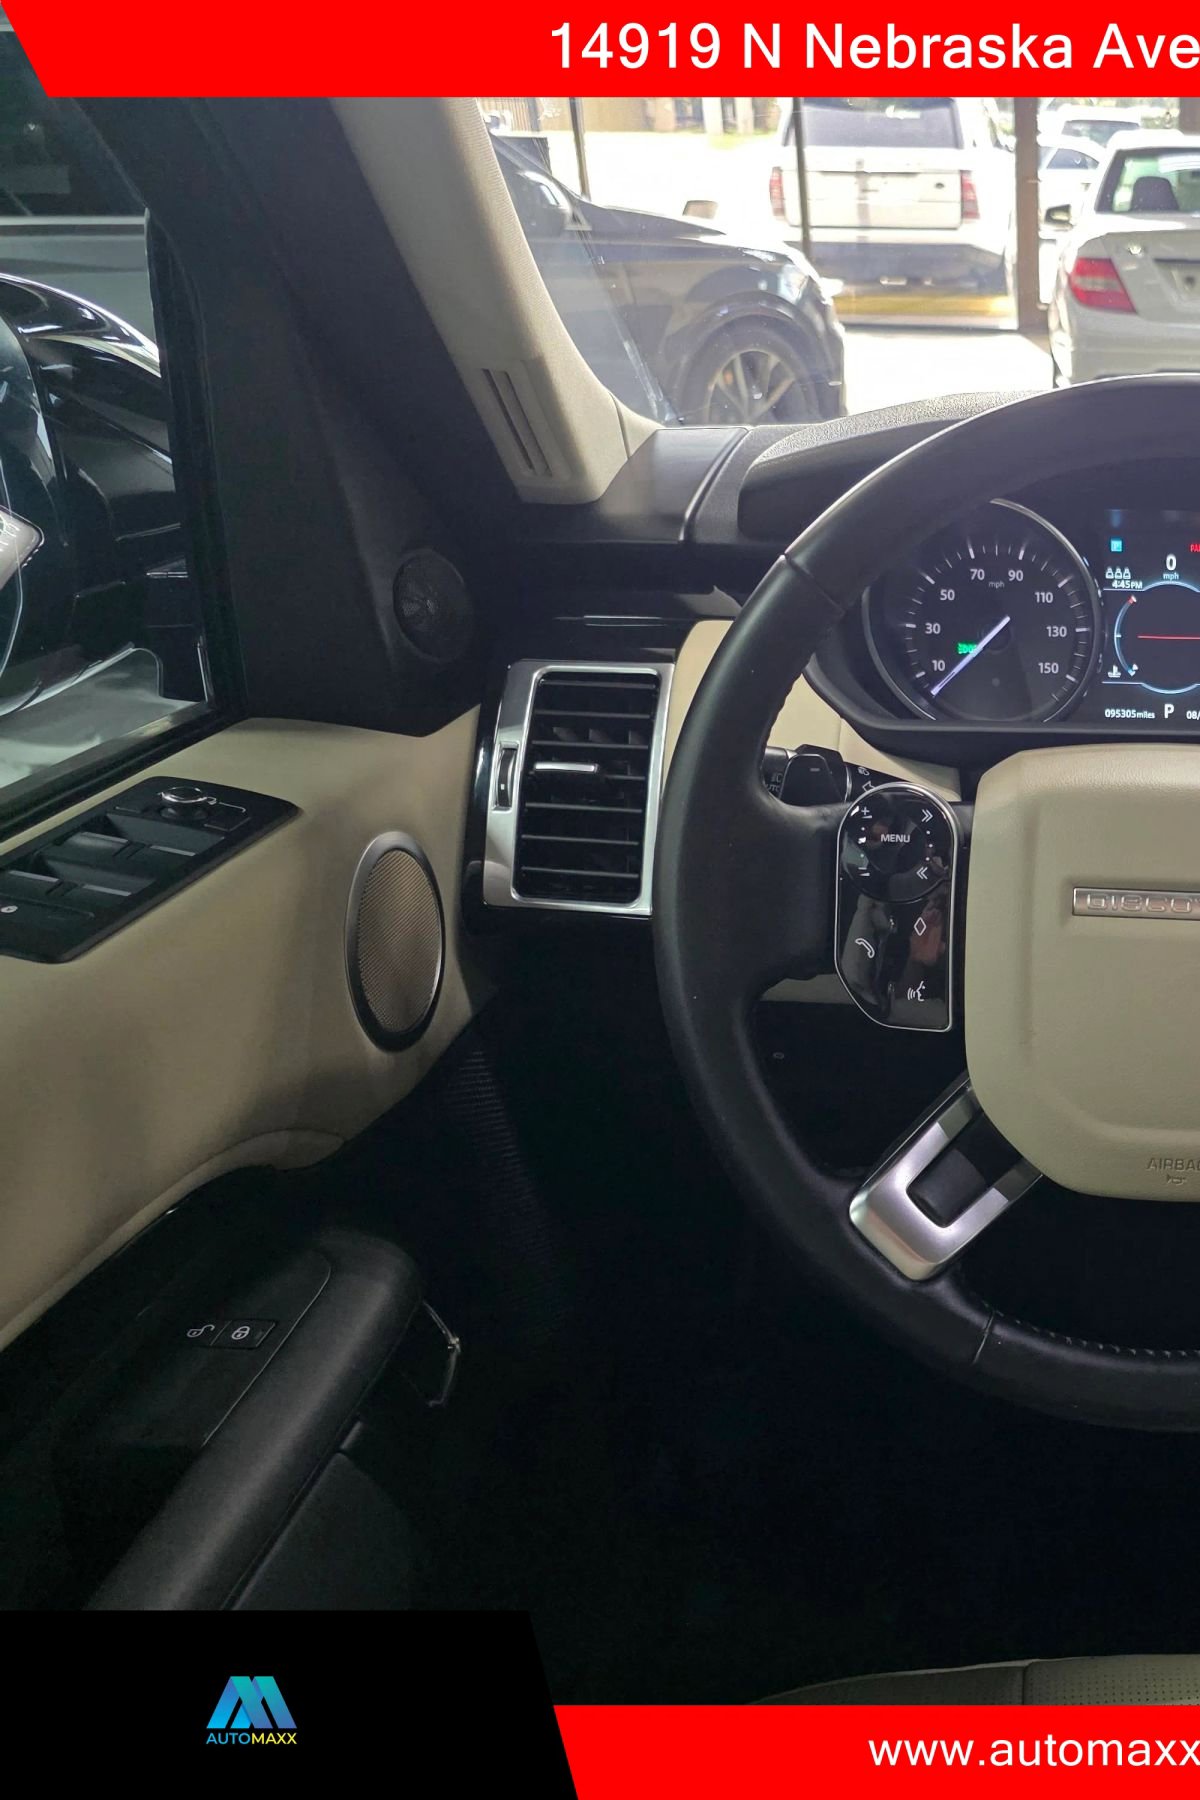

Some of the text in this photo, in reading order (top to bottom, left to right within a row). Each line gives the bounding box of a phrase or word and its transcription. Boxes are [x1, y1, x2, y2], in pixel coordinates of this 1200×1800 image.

[1166, 554, 1177, 571] 0
[970, 569, 985, 580] 70
[1008, 570, 1024, 581] 90
[1163, 573, 1179, 581] mph
[988, 581, 1005, 589] mph
[940, 589, 955, 601] 50
[1034, 592, 1054, 603] 110
[925, 623, 941, 634] 30
[1046, 626, 1067, 638] 130
[932, 660, 946, 671] 10
[1038, 662, 1059, 674] 150
[1164, 703, 1175, 719] P
[879, 833, 911, 843] MENU
